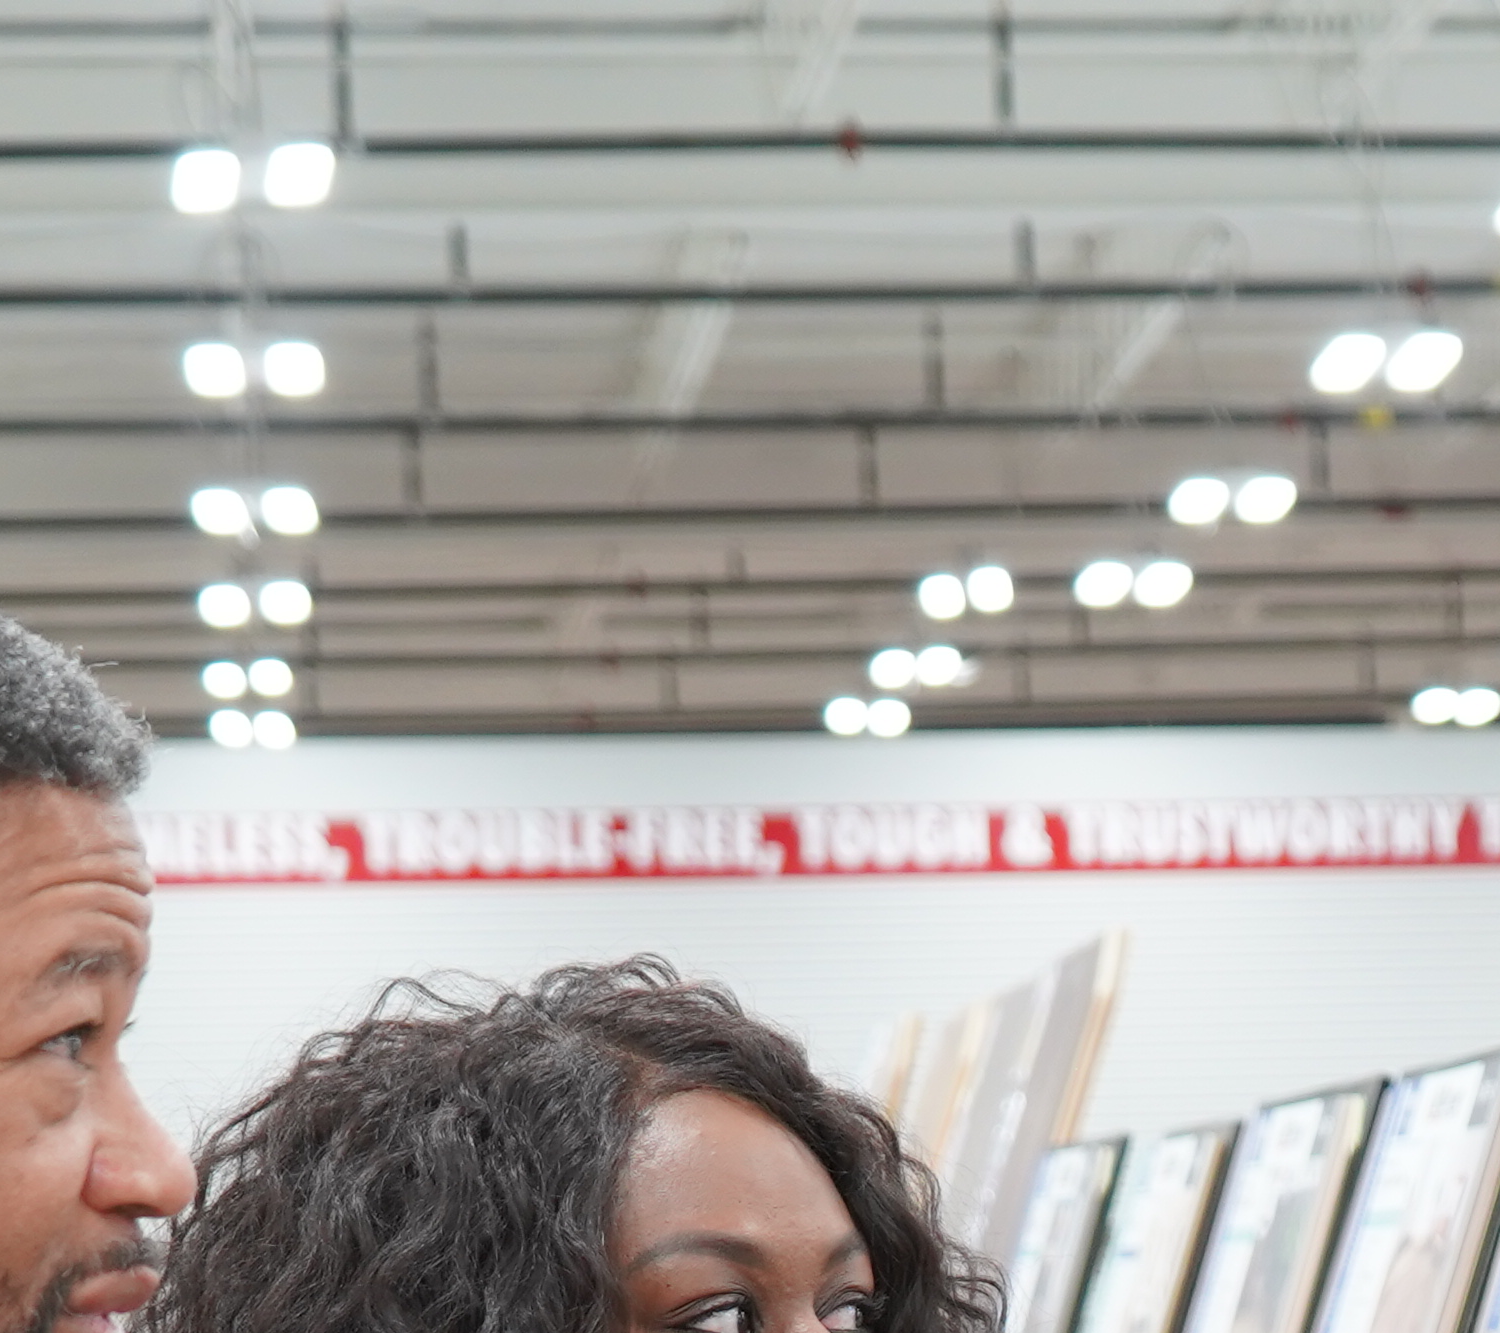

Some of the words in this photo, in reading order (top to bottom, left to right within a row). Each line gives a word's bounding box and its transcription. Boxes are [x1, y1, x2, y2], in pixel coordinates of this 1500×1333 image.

[366, 802, 784, 880] TROUBLE-FREE,
[798, 800, 990, 874] TOUGH
[1001, 804, 1056, 866] &
[1064, 798, 1463, 868] TRUSTWORTHY
